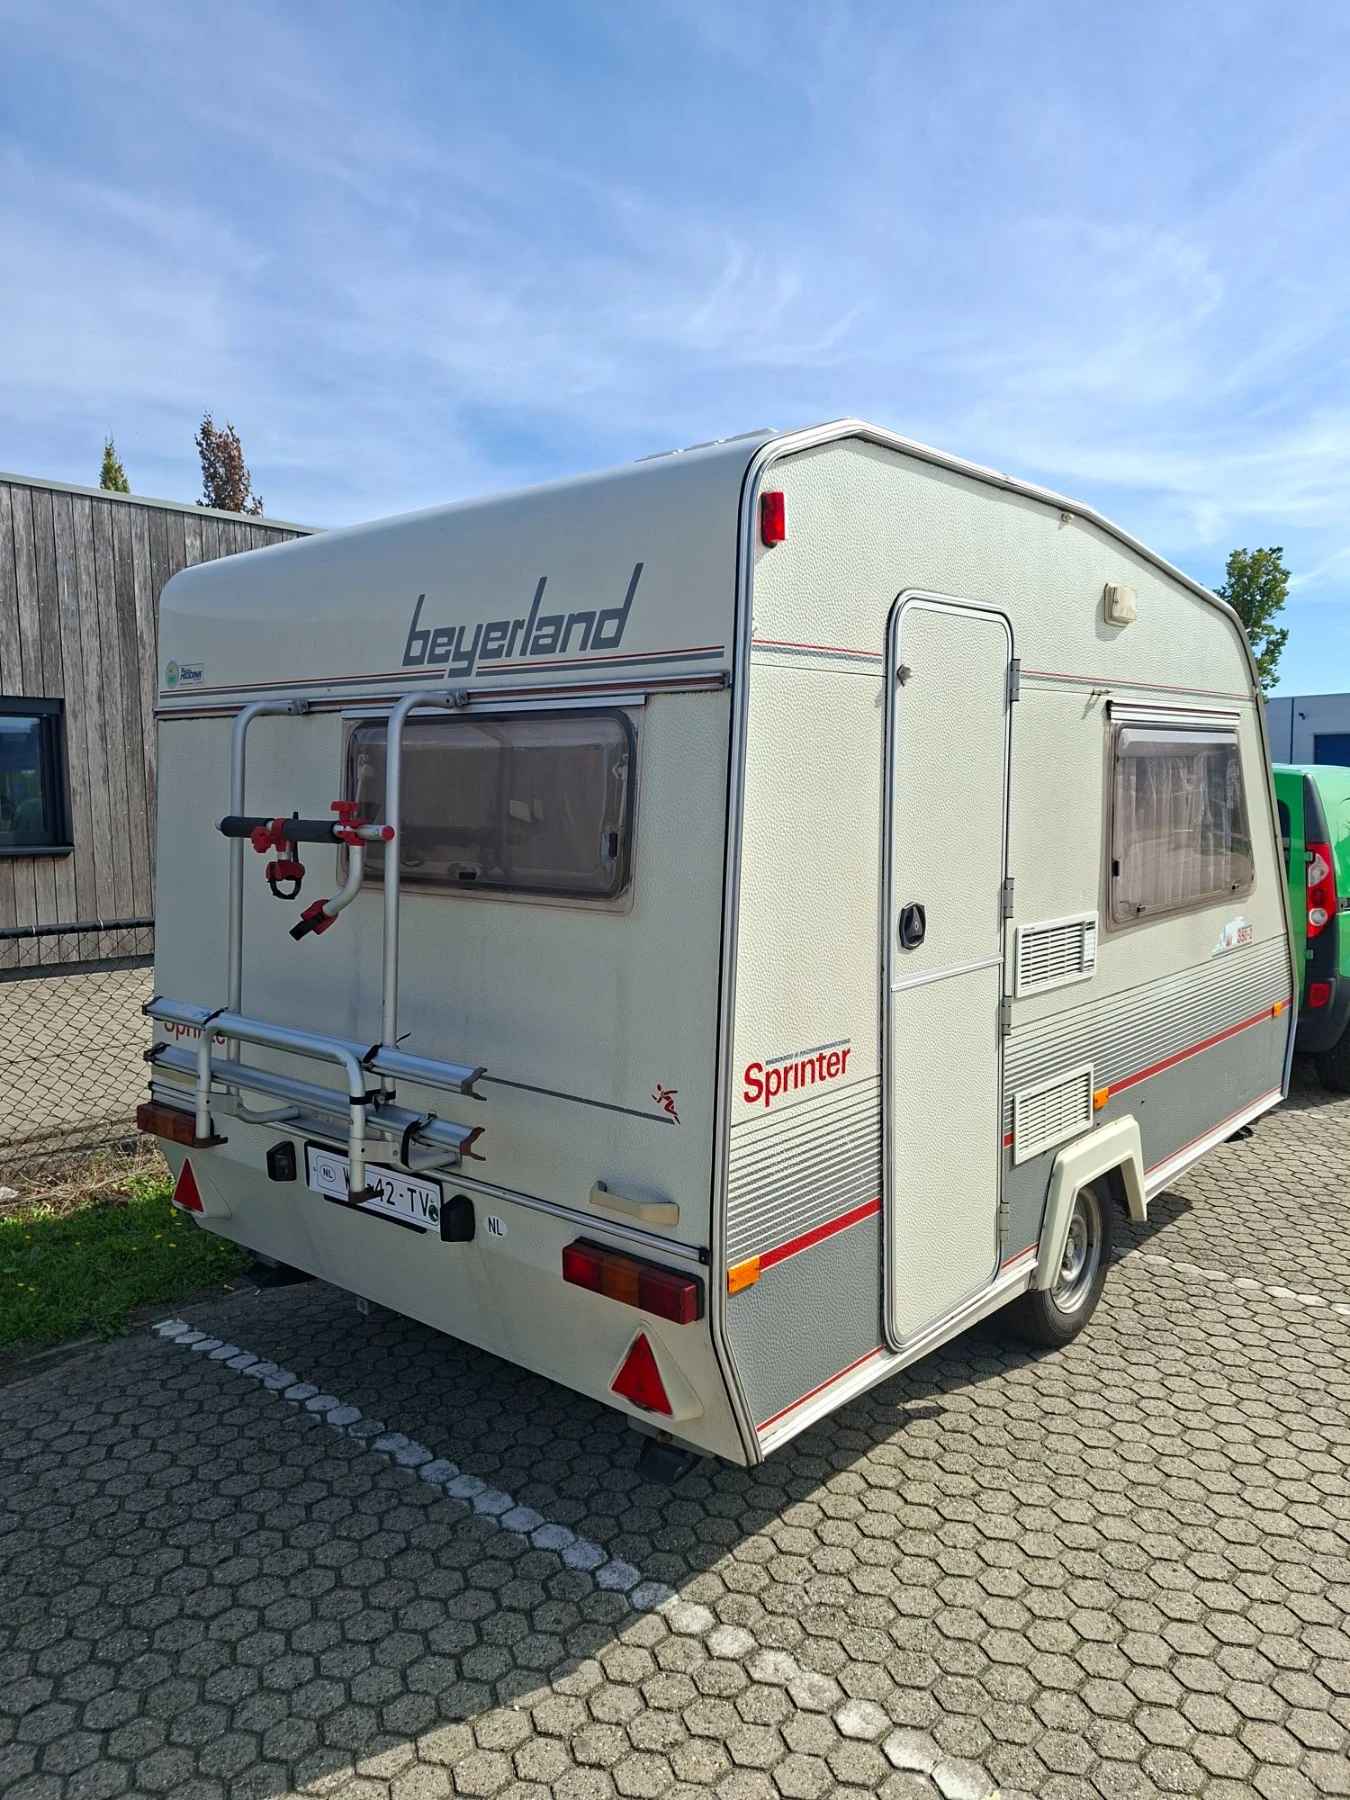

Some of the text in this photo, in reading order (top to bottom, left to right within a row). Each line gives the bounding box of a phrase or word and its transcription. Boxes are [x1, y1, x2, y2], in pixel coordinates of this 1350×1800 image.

[402, 562, 644, 678] beyerland
[743, 1047, 851, 1108] Sprinter
[322, 1167, 335, 1180] NL
[342, 1166, 429, 1217] W-42-TV
[487, 1216, 504, 1237] NL
